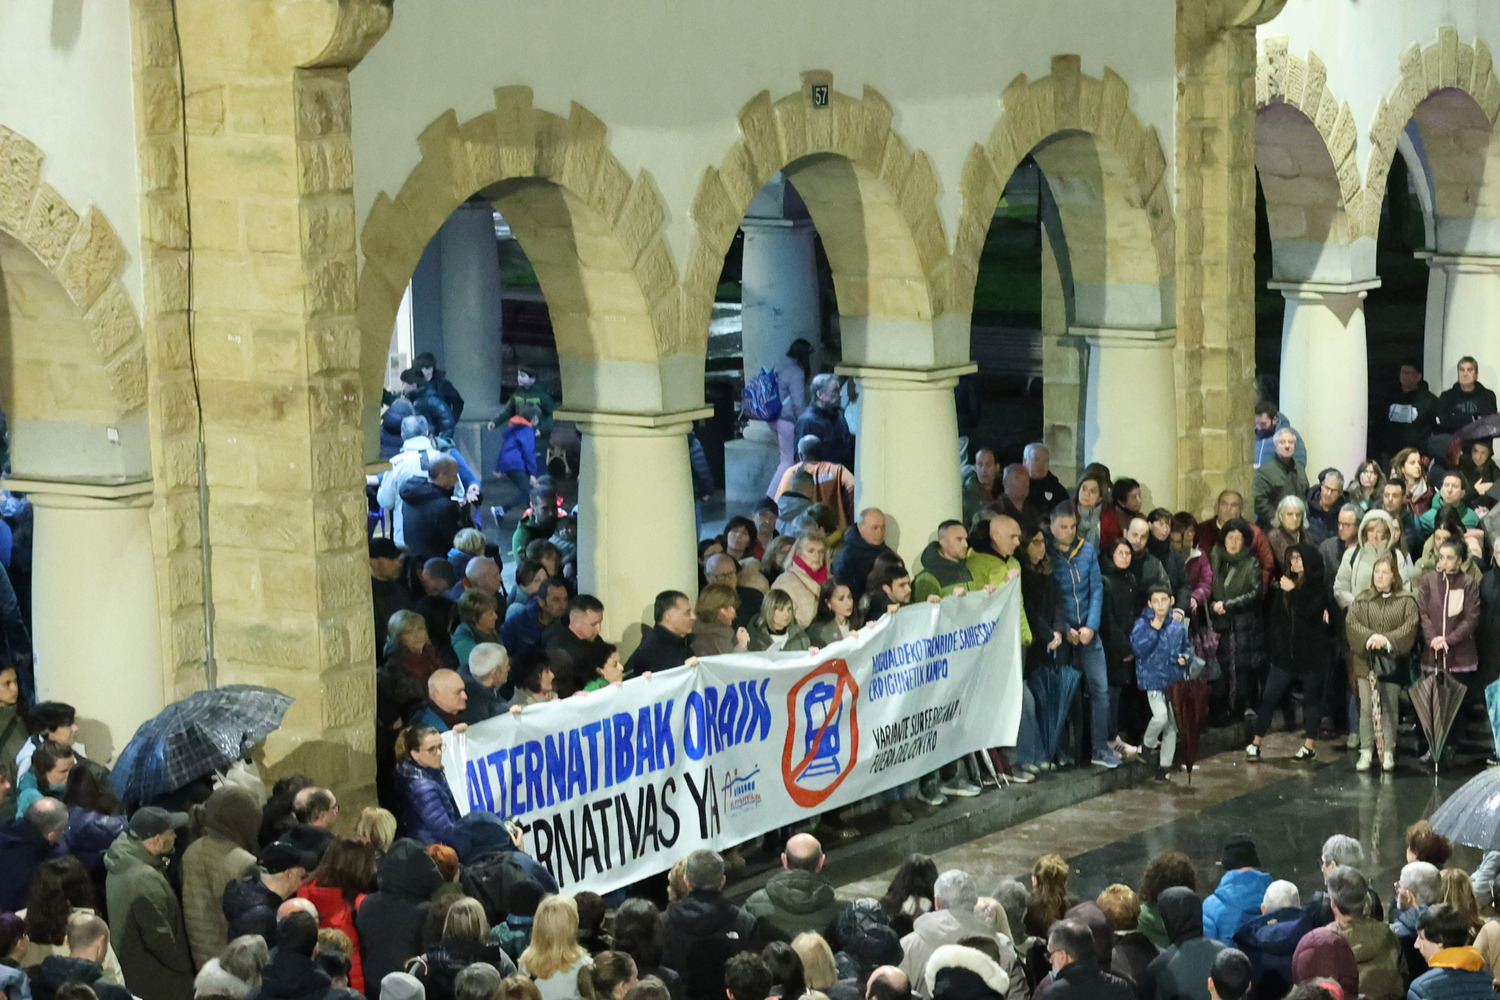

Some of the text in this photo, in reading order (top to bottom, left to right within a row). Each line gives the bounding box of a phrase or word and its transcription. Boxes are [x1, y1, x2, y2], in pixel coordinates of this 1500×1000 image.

[815, 87, 827, 105] 57
[466, 678, 772, 820] ALTERNATIBAK ORAIN
[523, 764, 721, 889] RNATIVAS YA
